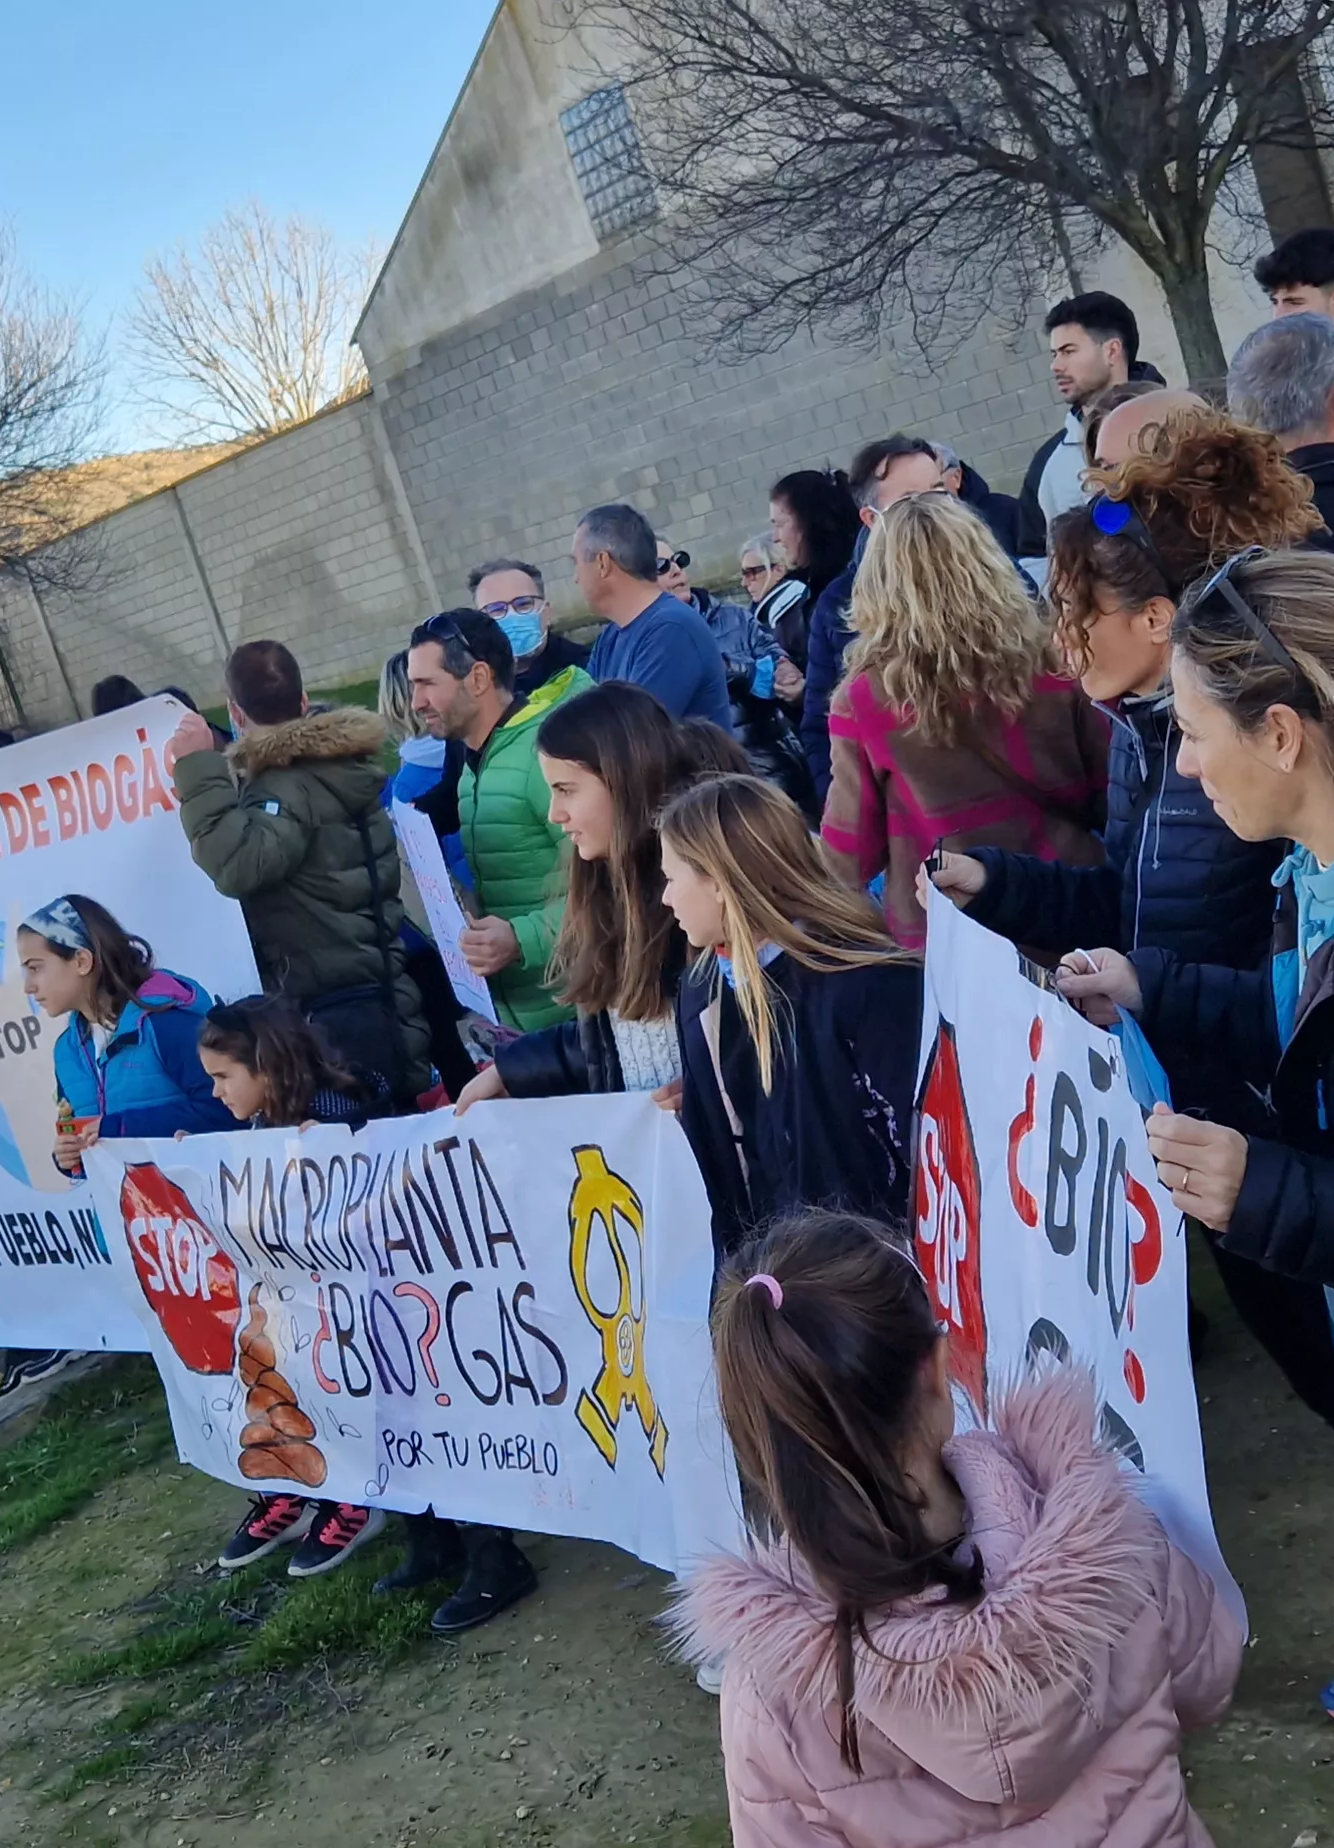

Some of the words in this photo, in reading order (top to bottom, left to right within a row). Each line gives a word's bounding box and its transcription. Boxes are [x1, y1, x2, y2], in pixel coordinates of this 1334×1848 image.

[220, 1136, 526, 1277] MACROPLANTA
[130, 1217, 217, 1301] STOP
[382, 1428, 434, 1468] POR
[432, 1431, 468, 1469] TU
[478, 1432, 558, 1476] PUEBLO
